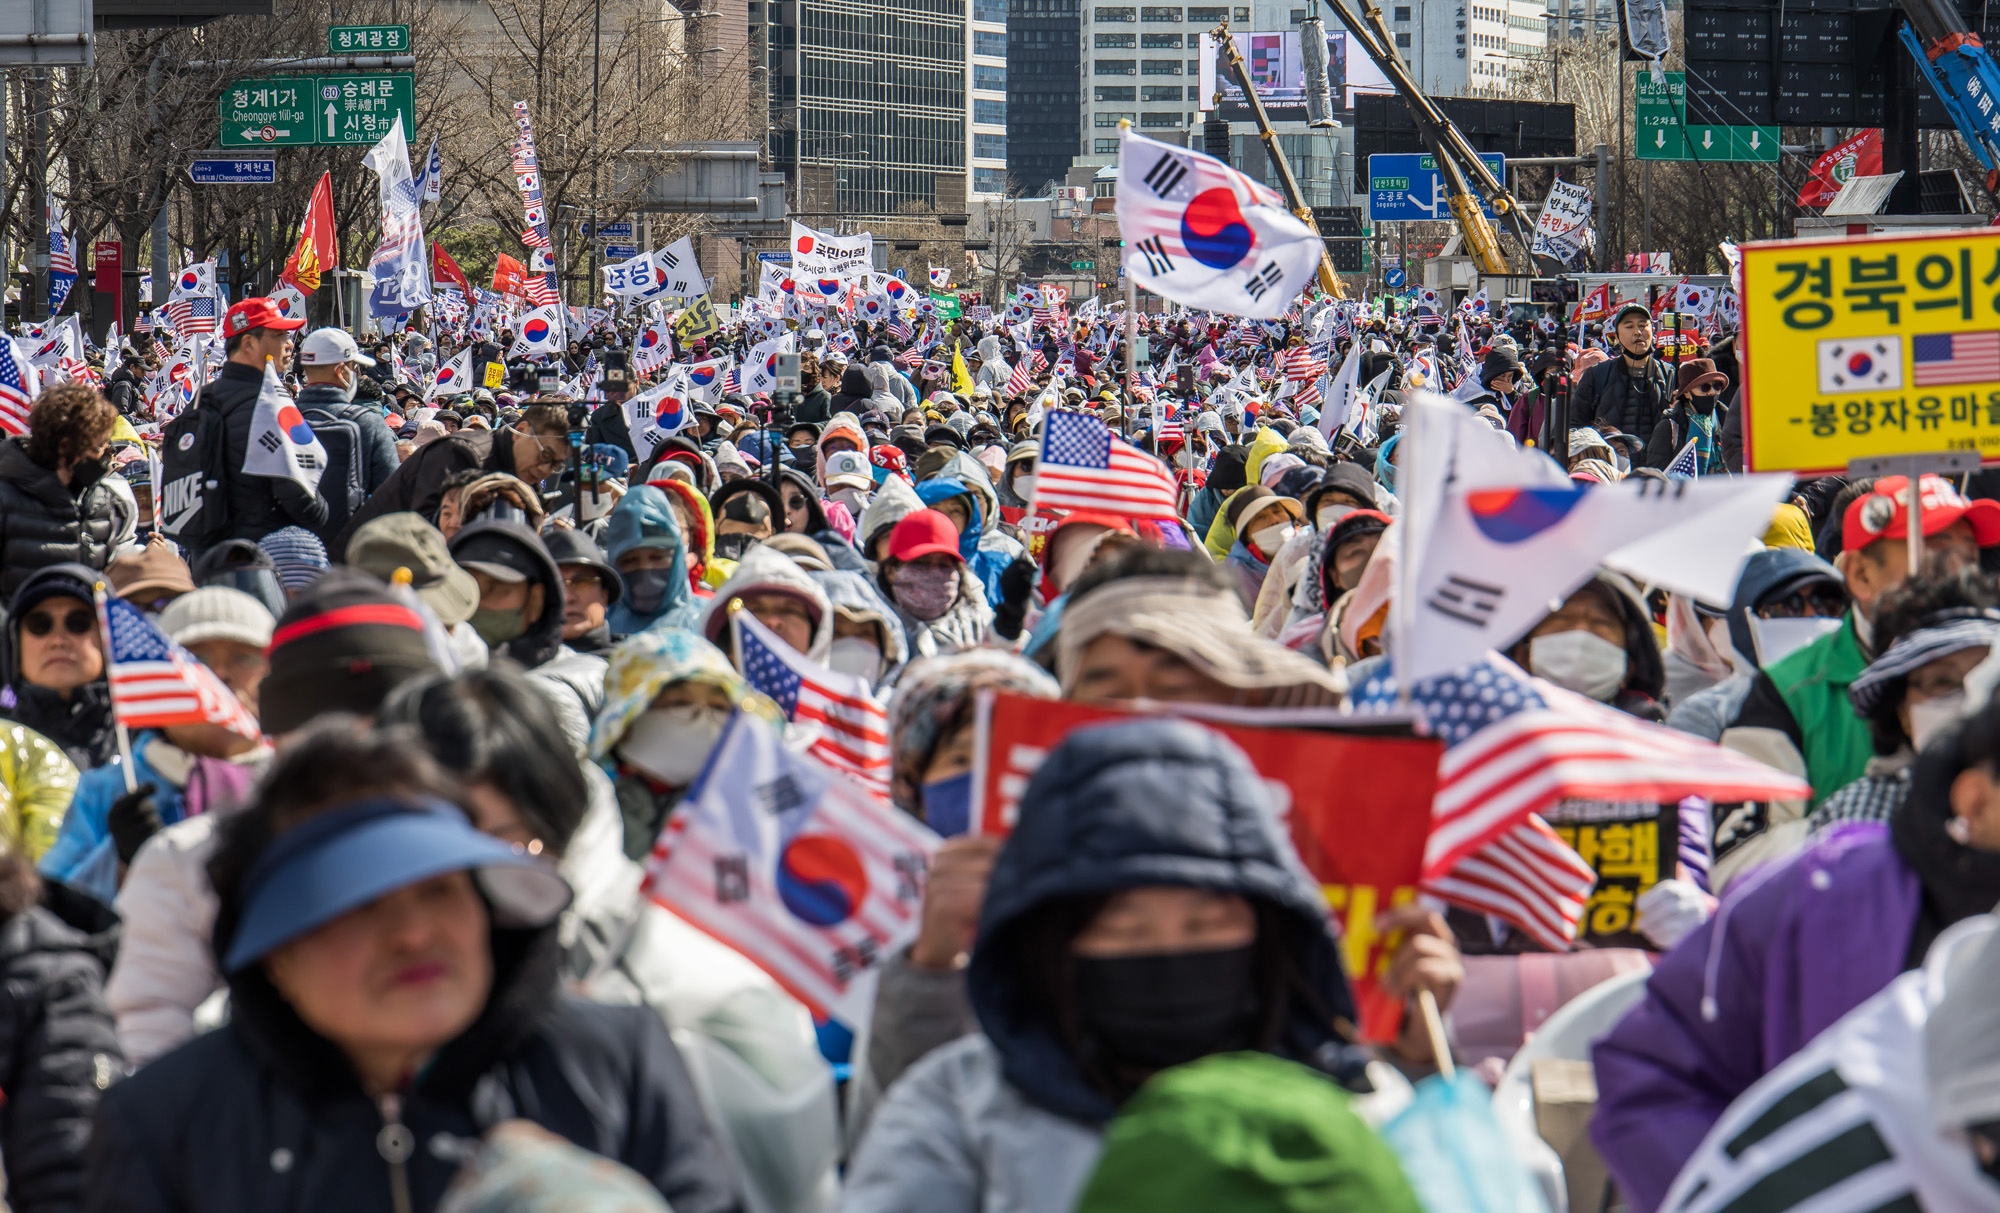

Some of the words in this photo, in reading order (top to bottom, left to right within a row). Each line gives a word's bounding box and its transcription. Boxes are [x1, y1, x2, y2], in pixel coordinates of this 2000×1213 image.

[338, 30, 400, 47] 청계광장
[324, 88, 337, 98] 60
[342, 79, 395, 97] 숭례문
[232, 88, 298, 109] 청계1가
[232, 110, 277, 124] Cheonggye
[344, 131, 364, 142] City
[234, 162, 271, 173] 청계천로
[1377, 191, 1404, 201] 소공로
[163, 471, 204, 518] NIKE
